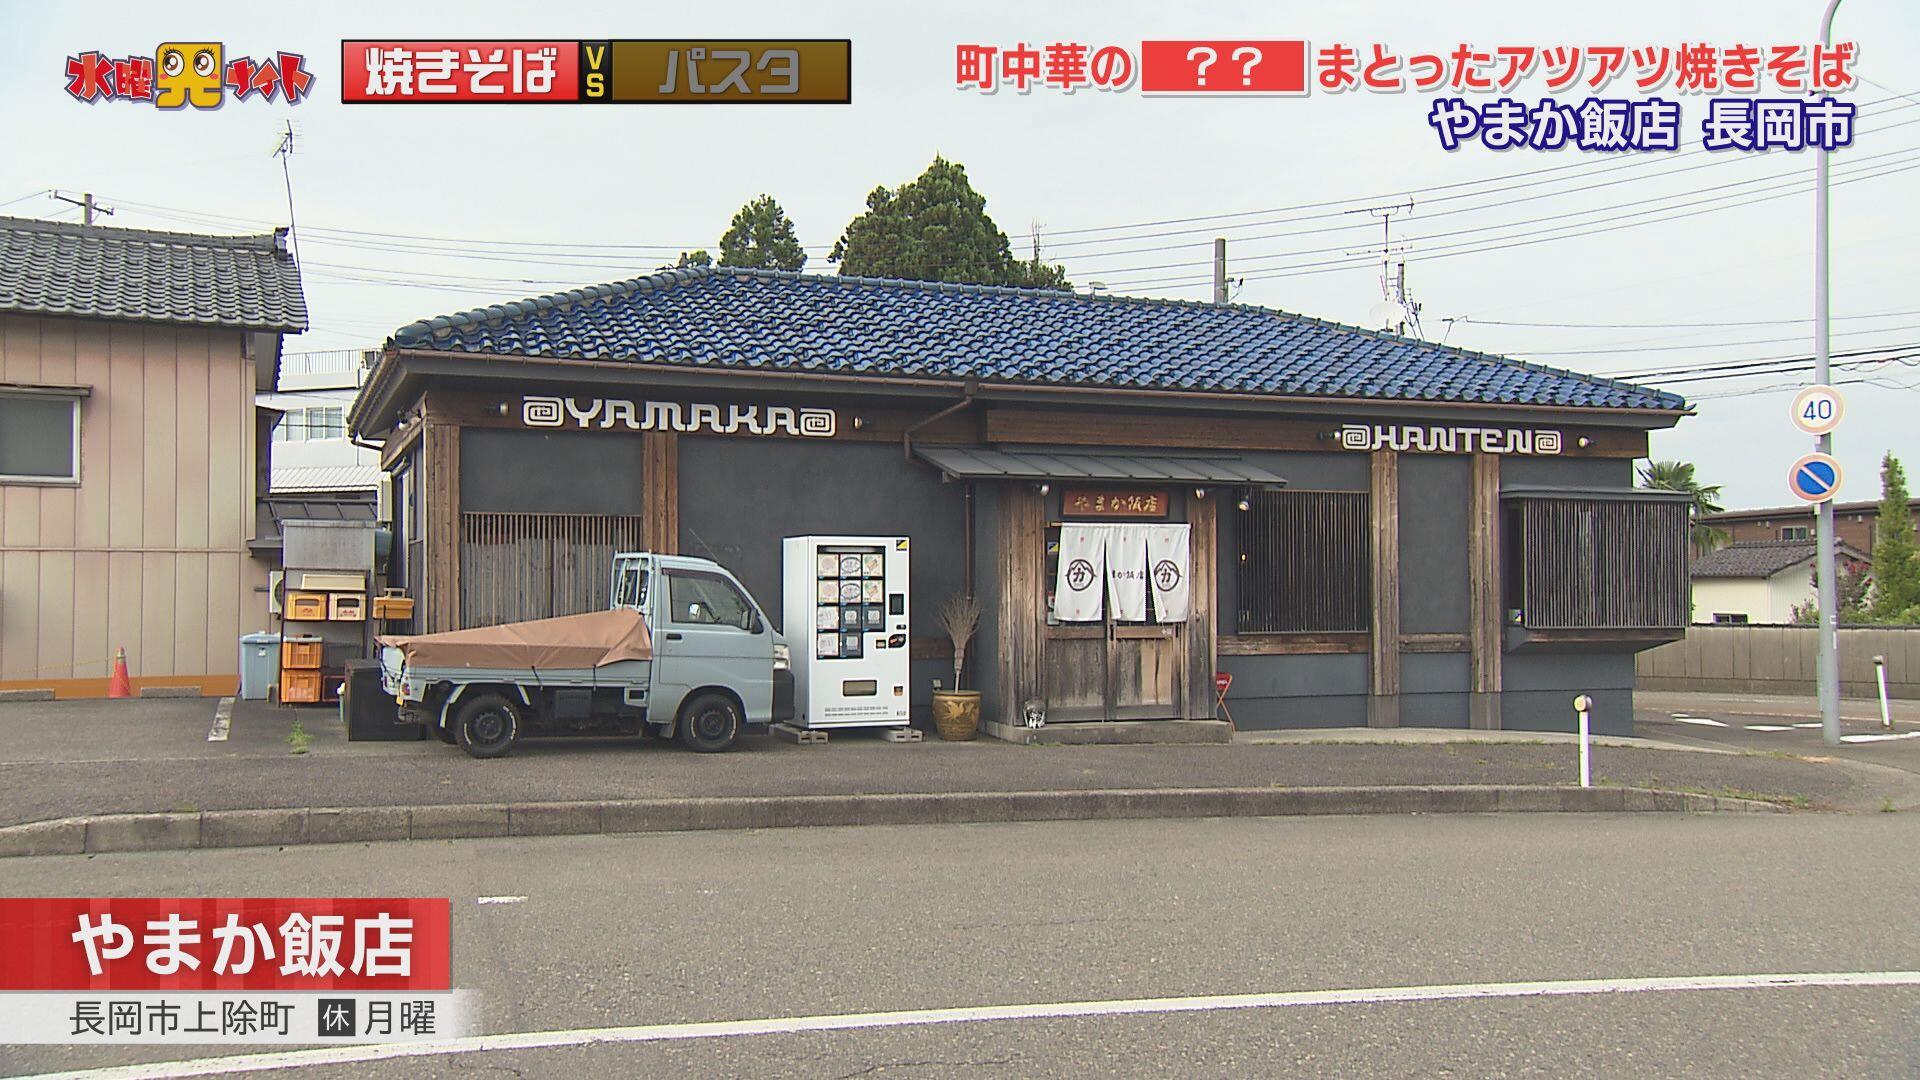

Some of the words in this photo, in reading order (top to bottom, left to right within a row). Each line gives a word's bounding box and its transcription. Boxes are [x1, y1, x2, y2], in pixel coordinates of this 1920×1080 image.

[565, 398, 799, 435] YAMAKA
[1803, 399, 1832, 420] 40
[1371, 425, 1532, 454] HANTEN
[1074, 495, 1157, 512] やまか飯店
